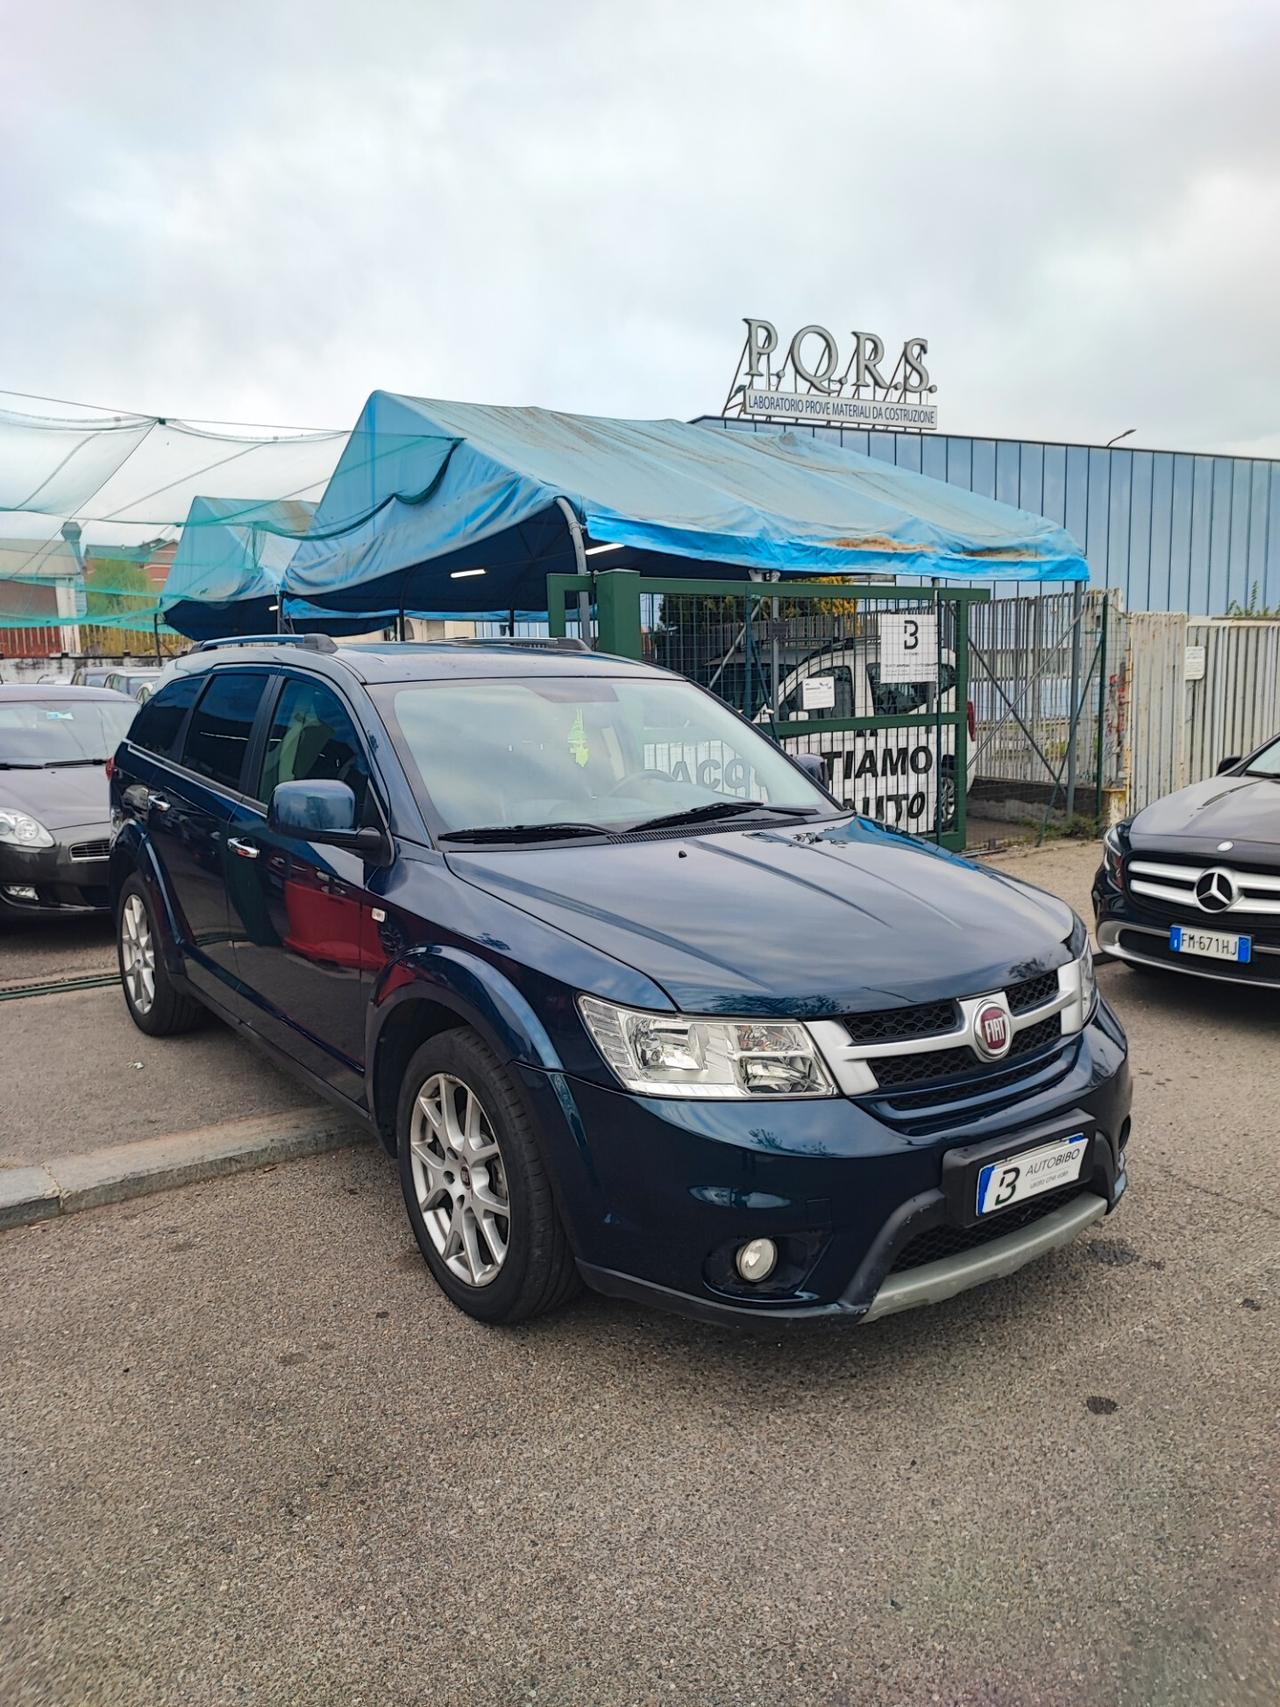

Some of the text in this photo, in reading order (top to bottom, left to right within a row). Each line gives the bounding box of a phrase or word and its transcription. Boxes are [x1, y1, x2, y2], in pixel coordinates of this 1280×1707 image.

[742, 318, 938, 394] P.Q.R.S.
[748, 394, 935, 424] LABORATORIO PROVE MATERIALI DA COSTRUZIONE
[984, 1017, 1005, 1043] FIAT
[1025, 1149, 1080, 1177] AUTOBIBO
